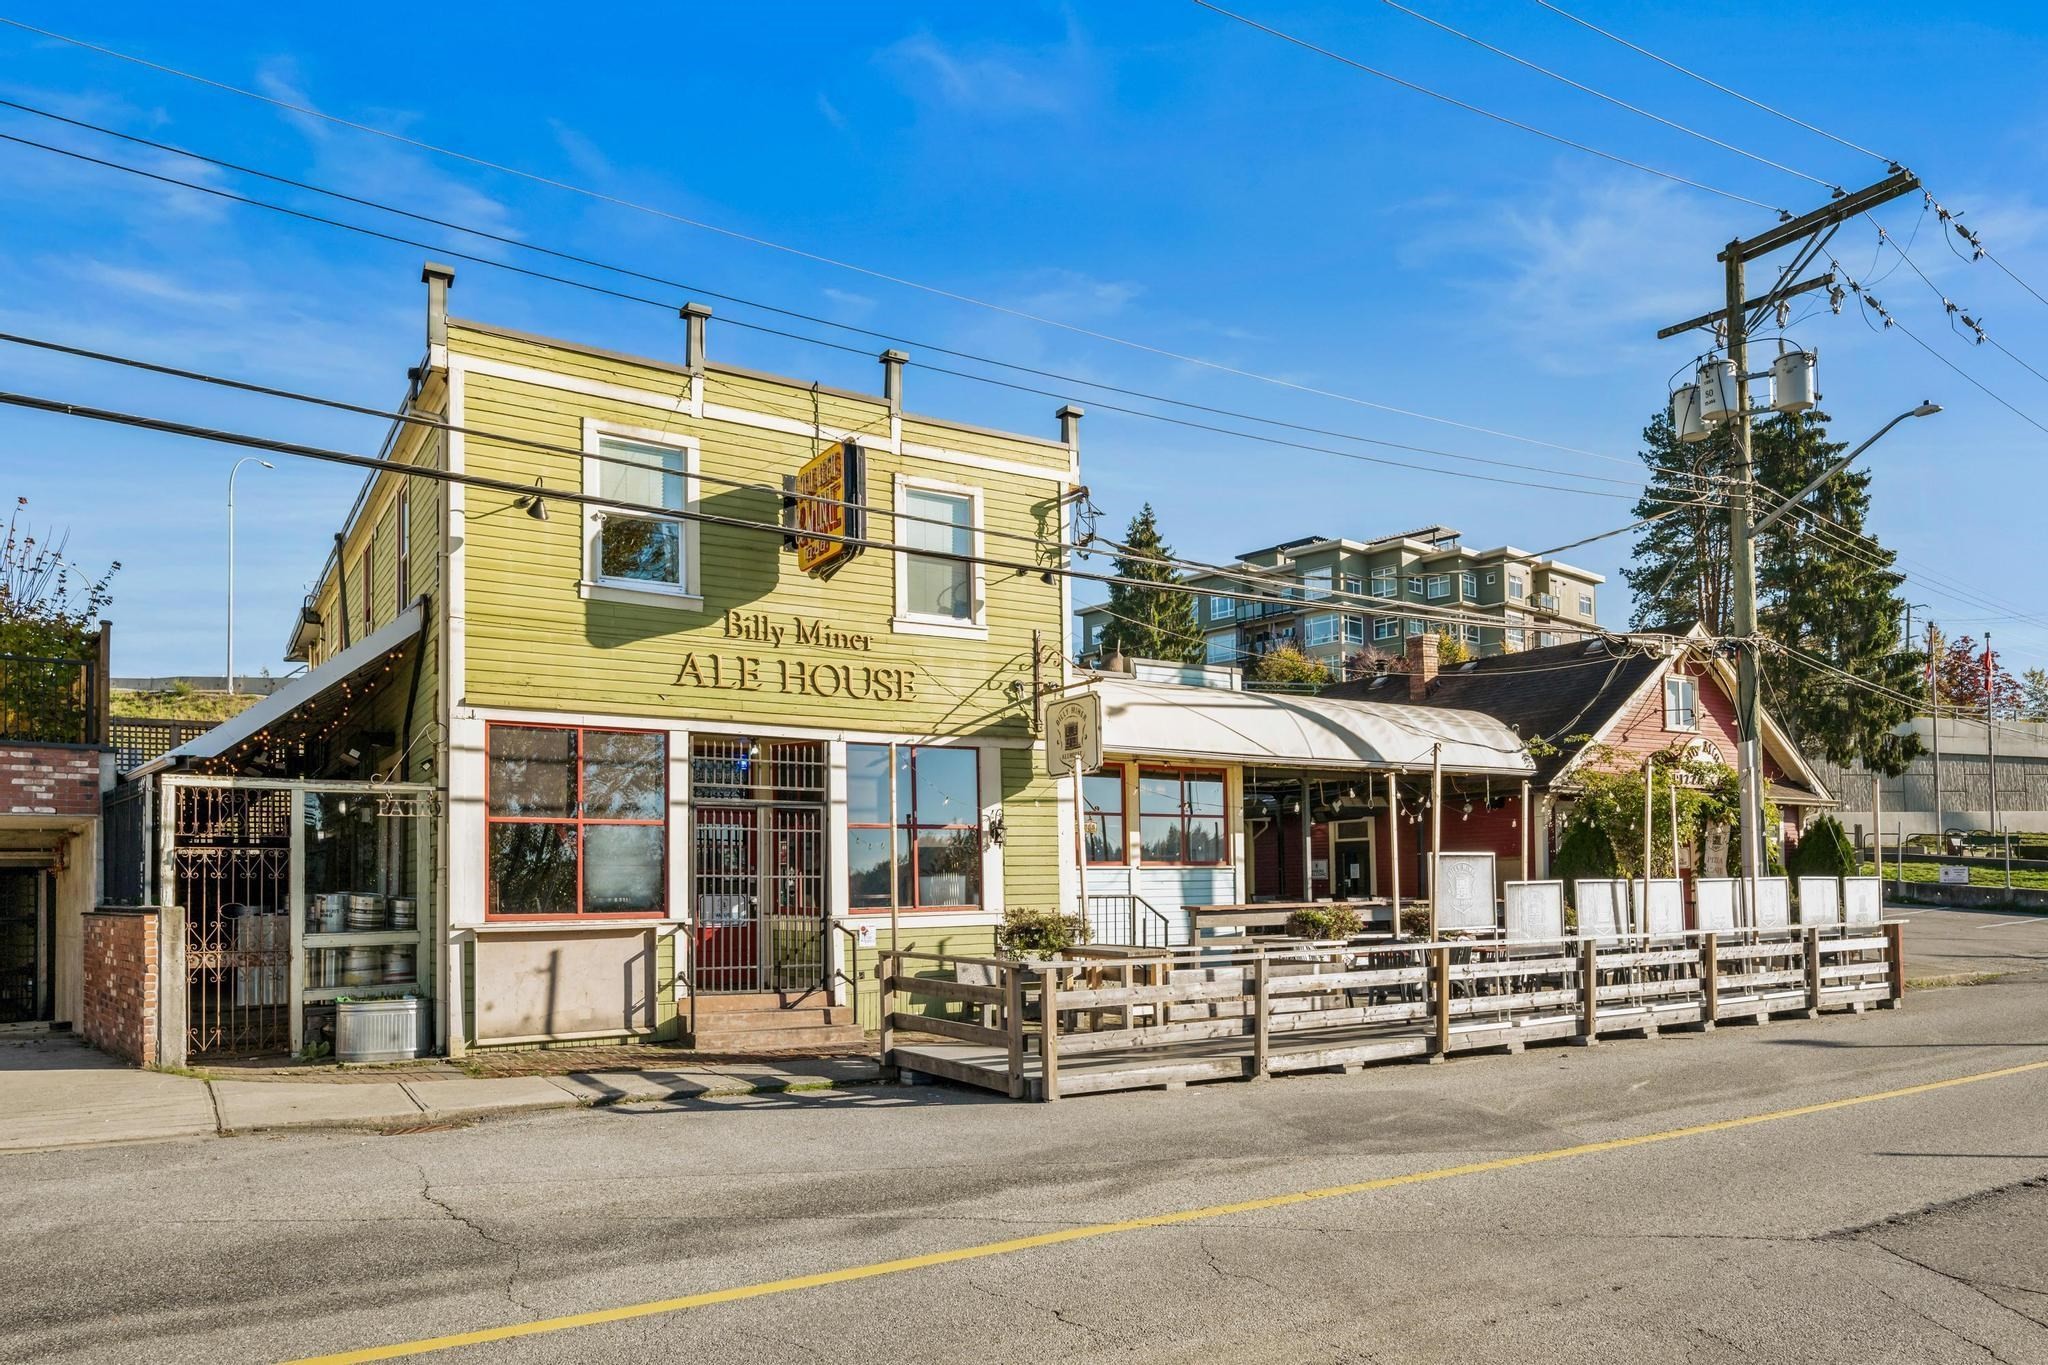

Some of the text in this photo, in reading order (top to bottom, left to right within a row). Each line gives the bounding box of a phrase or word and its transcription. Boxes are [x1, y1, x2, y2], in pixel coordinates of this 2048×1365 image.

[724, 609, 875, 651] Billy Miner
[672, 652, 918, 702] ALE HOUSE
[376, 799, 443, 817] PATIO
